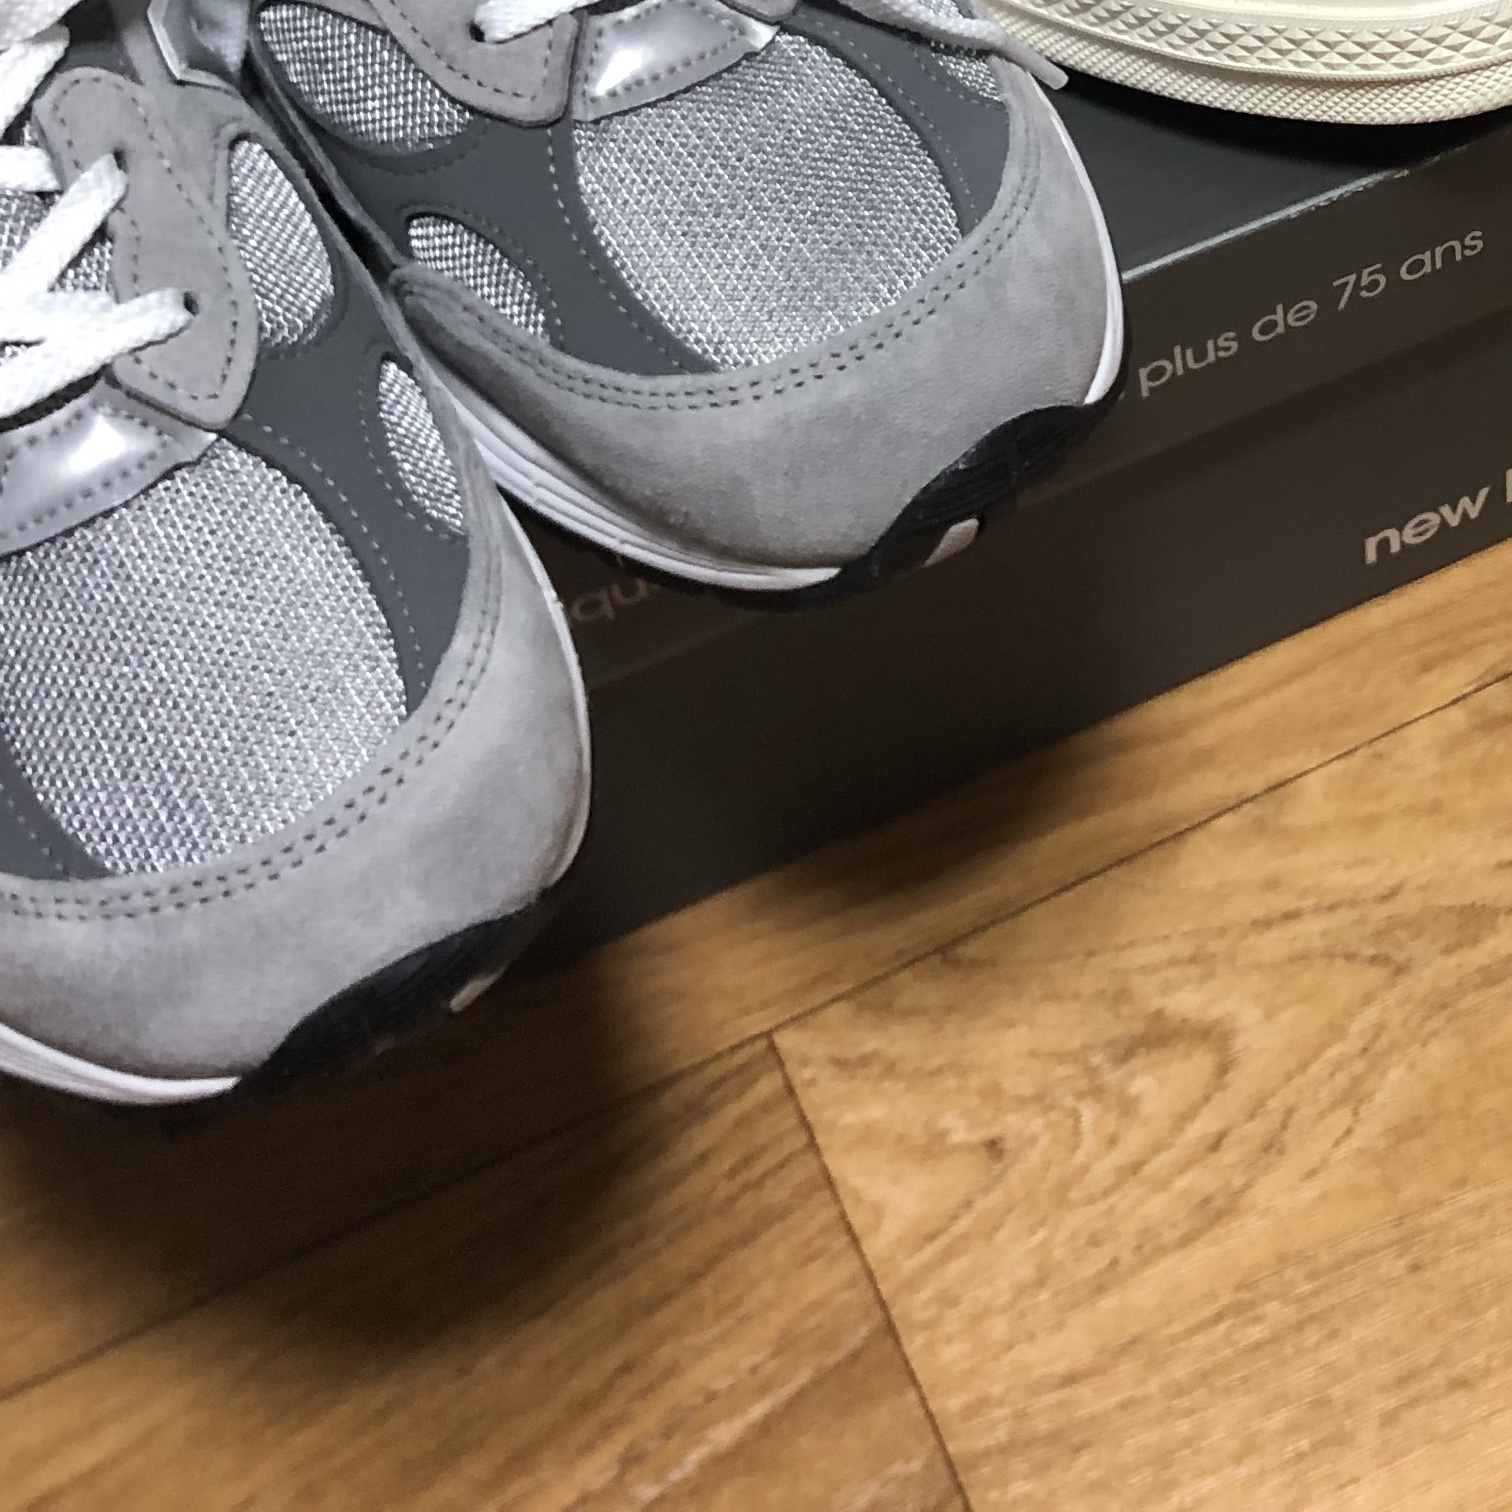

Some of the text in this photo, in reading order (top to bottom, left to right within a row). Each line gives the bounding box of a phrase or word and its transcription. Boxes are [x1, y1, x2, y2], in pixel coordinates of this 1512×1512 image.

[1138, 230, 1485, 398] plus de 75 ans
[1363, 485, 1491, 565] new
